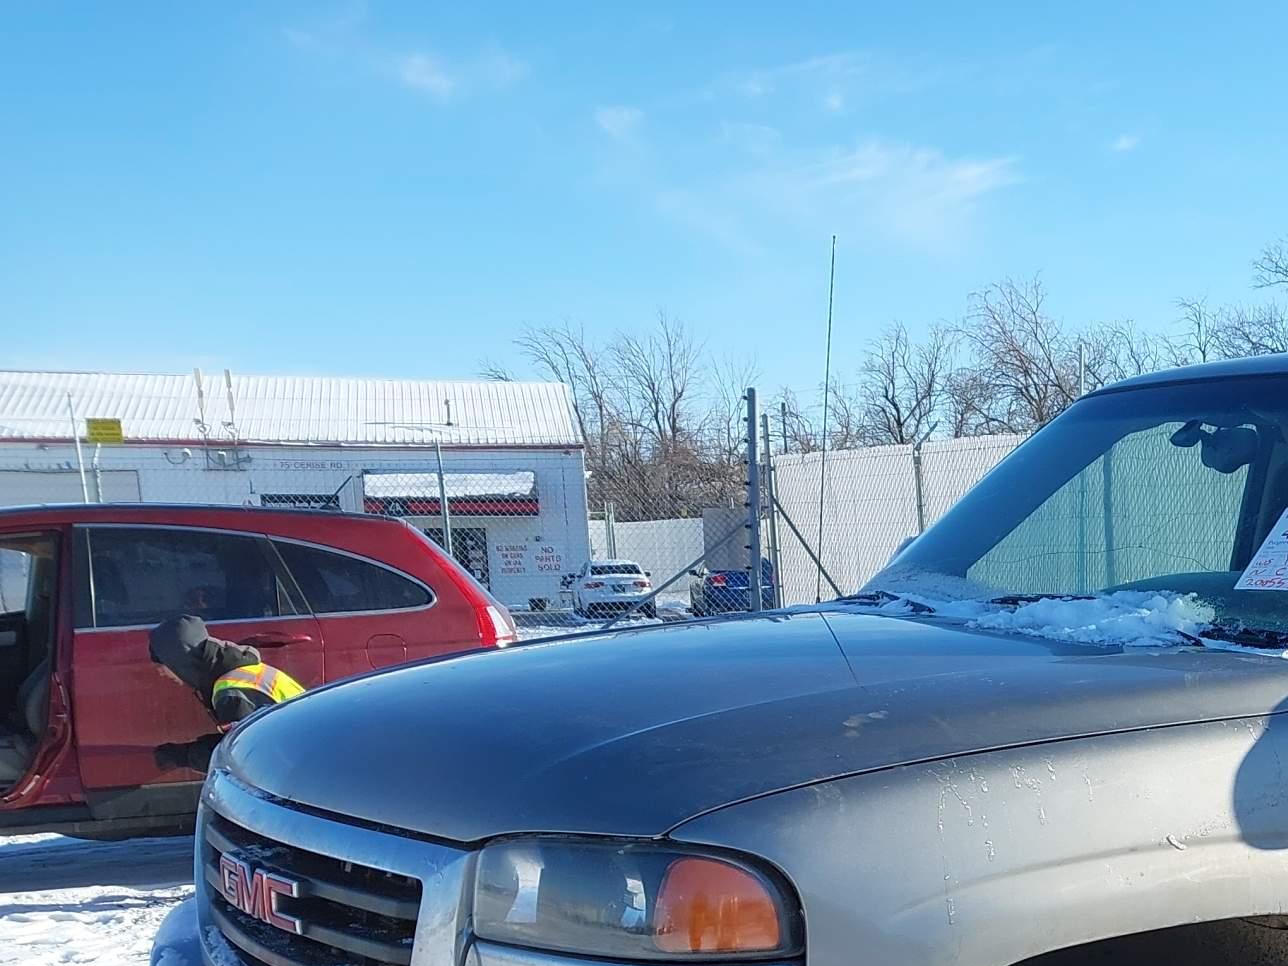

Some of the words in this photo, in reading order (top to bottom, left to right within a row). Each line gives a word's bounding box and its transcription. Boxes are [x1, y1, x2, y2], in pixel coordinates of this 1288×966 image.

[541, 546, 554, 554] NO
[535, 555, 561, 563] PARTS
[538, 563, 560, 572] SOLD
[220, 853, 302, 935] GMC
